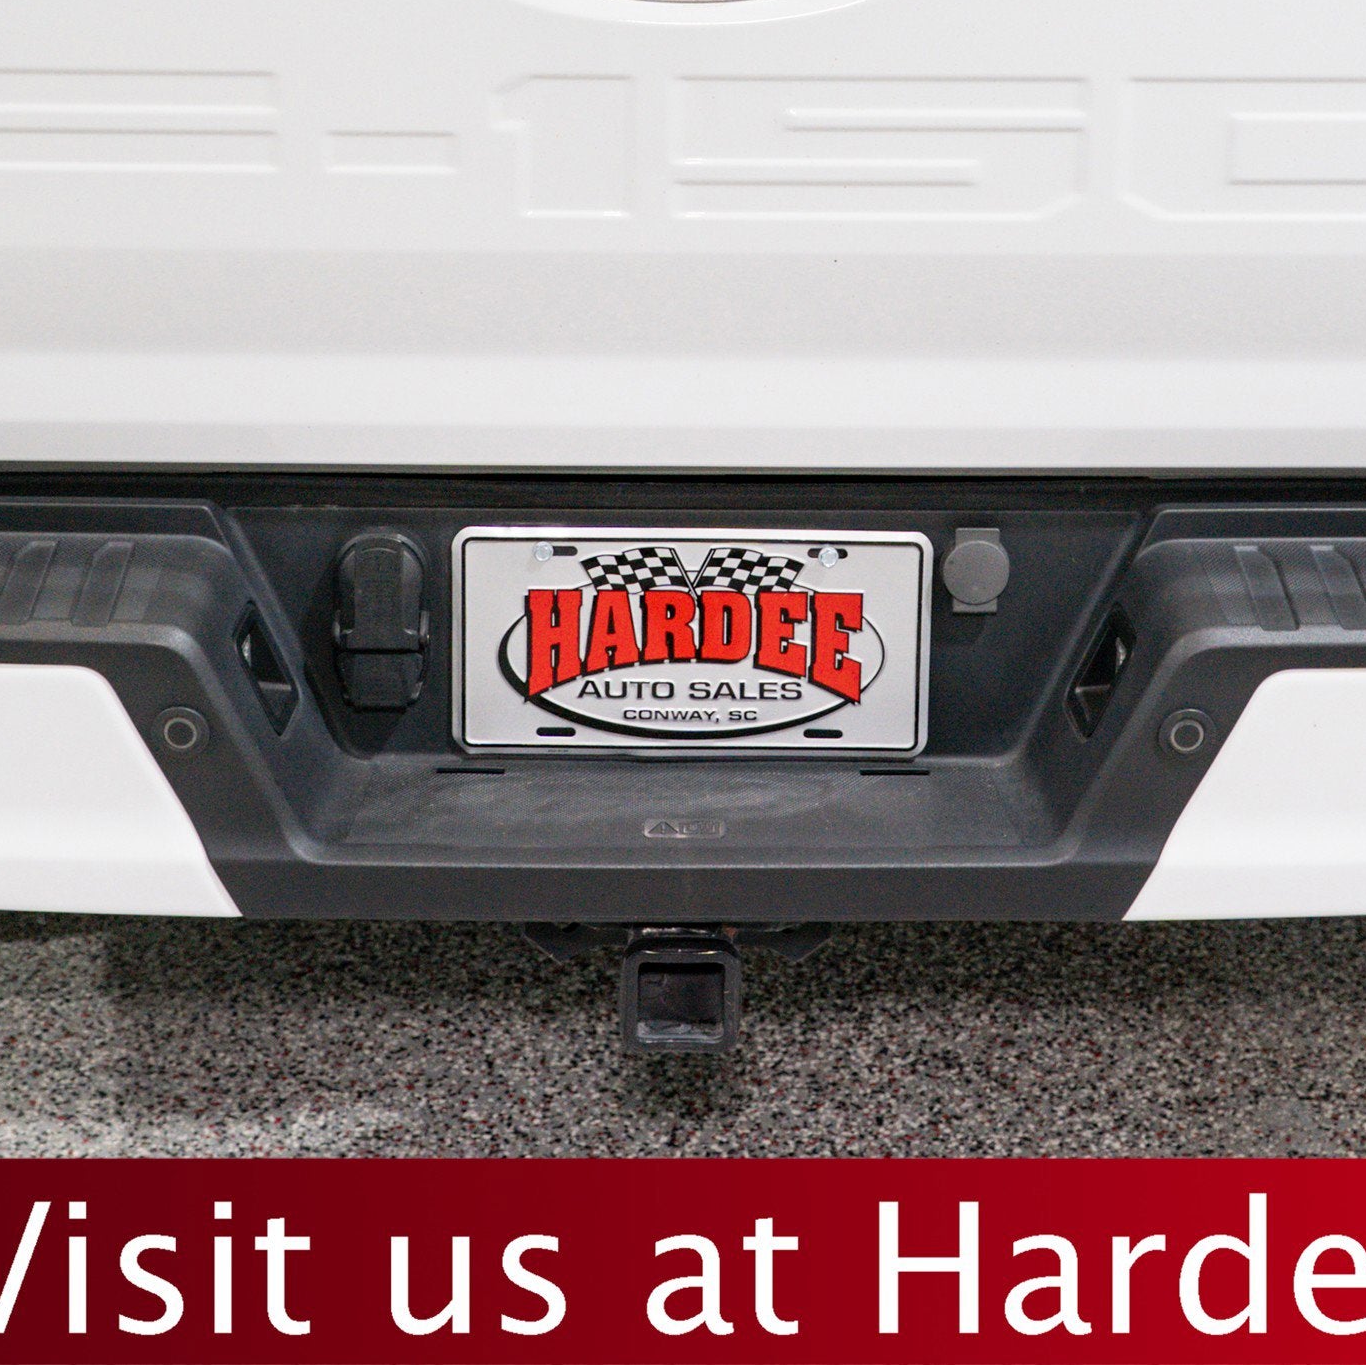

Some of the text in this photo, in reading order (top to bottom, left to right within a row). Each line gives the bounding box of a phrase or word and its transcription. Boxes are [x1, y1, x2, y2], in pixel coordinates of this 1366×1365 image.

[524, 588, 864, 704] HARDEE
[578, 680, 803, 701] AUTO SALES
[623, 708, 757, 724] CONWAY, SC
